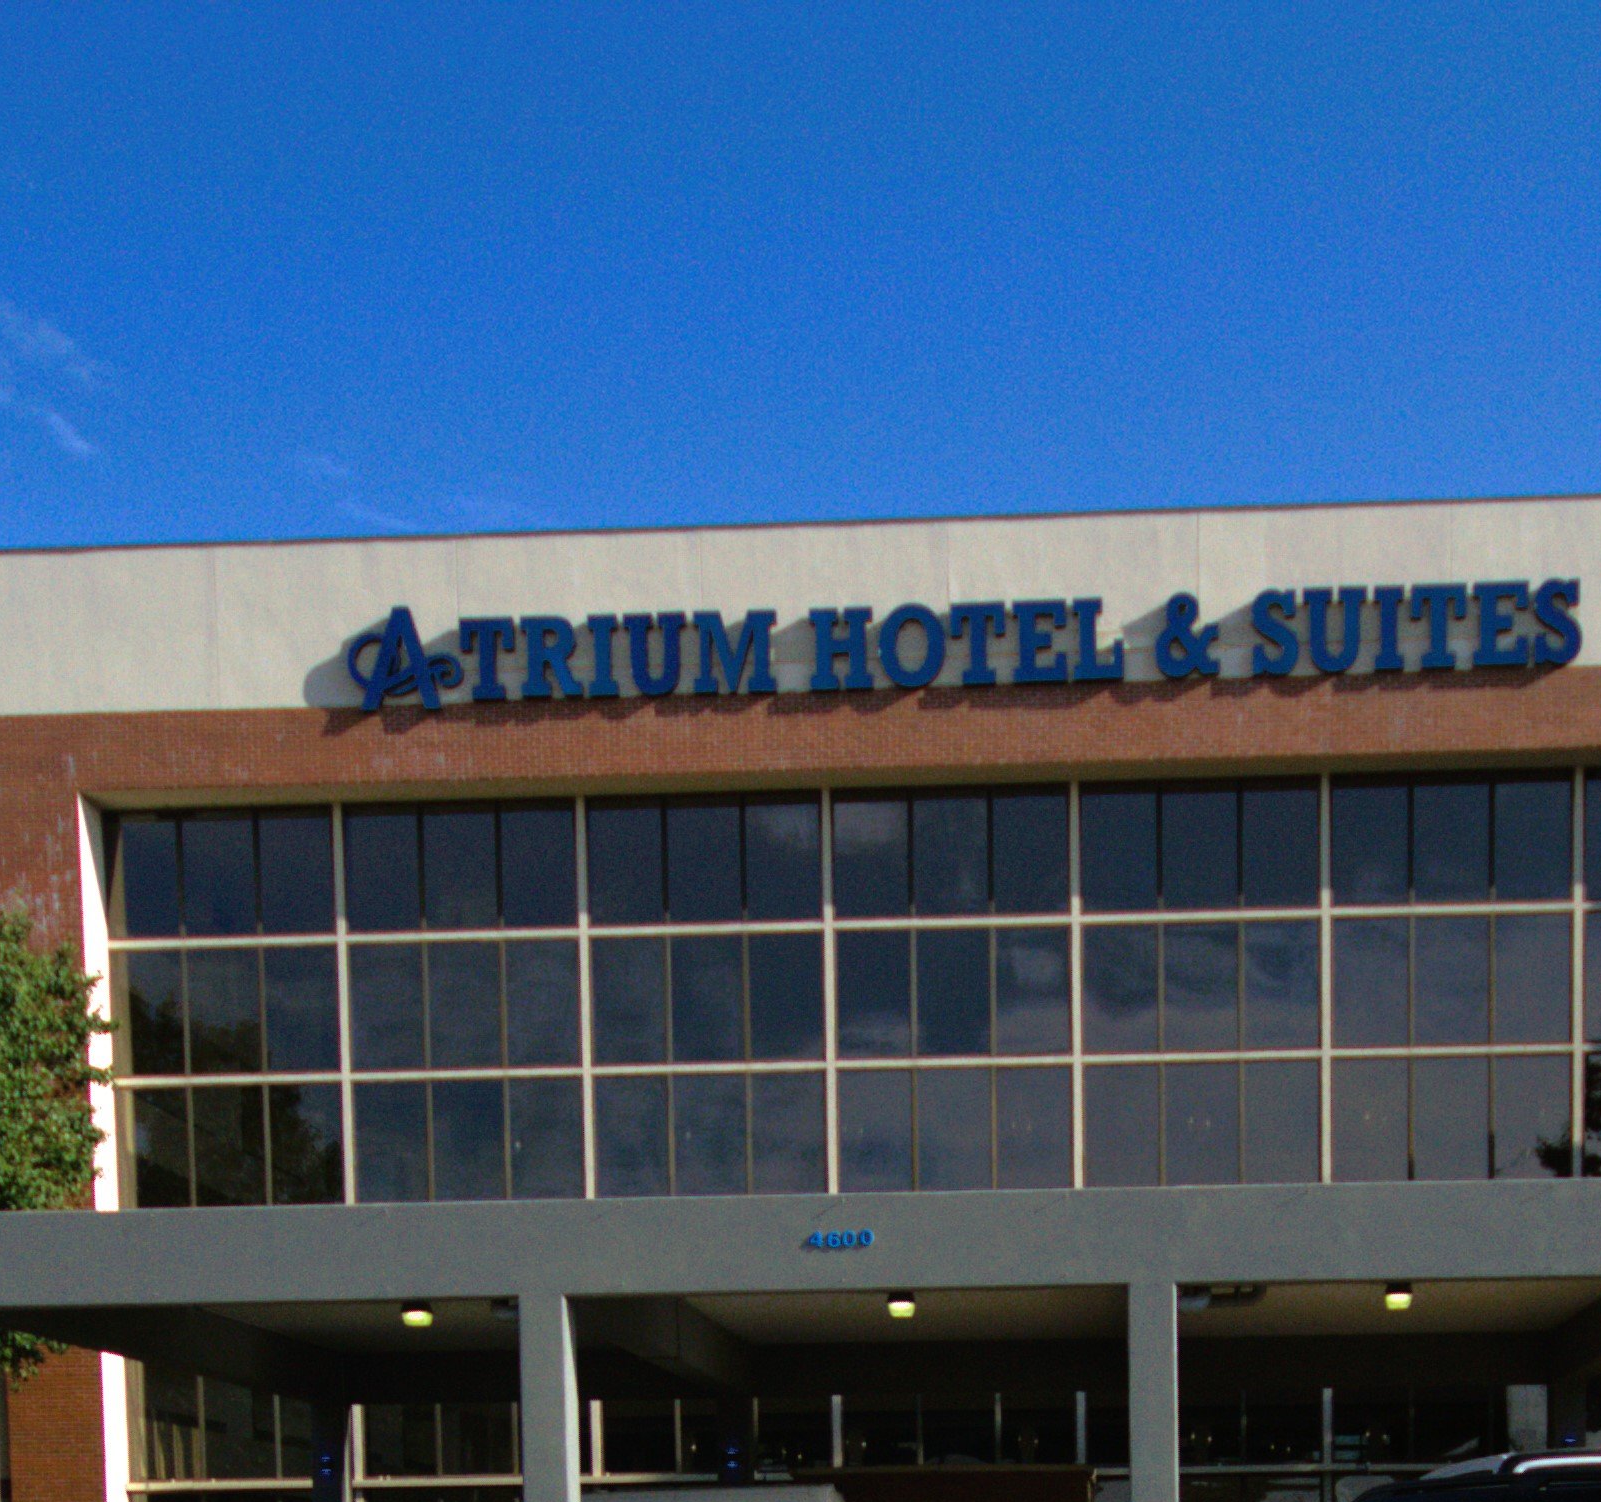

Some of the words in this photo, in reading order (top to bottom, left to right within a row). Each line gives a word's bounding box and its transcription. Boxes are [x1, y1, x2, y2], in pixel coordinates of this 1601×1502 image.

[347, 606, 779, 711] ATRIUM
[808, 597, 1125, 689] HOTEL
[1155, 592, 1220, 678] &
[1251, 578, 1583, 676] SUITES
[808, 1229, 875, 1248] 4600
